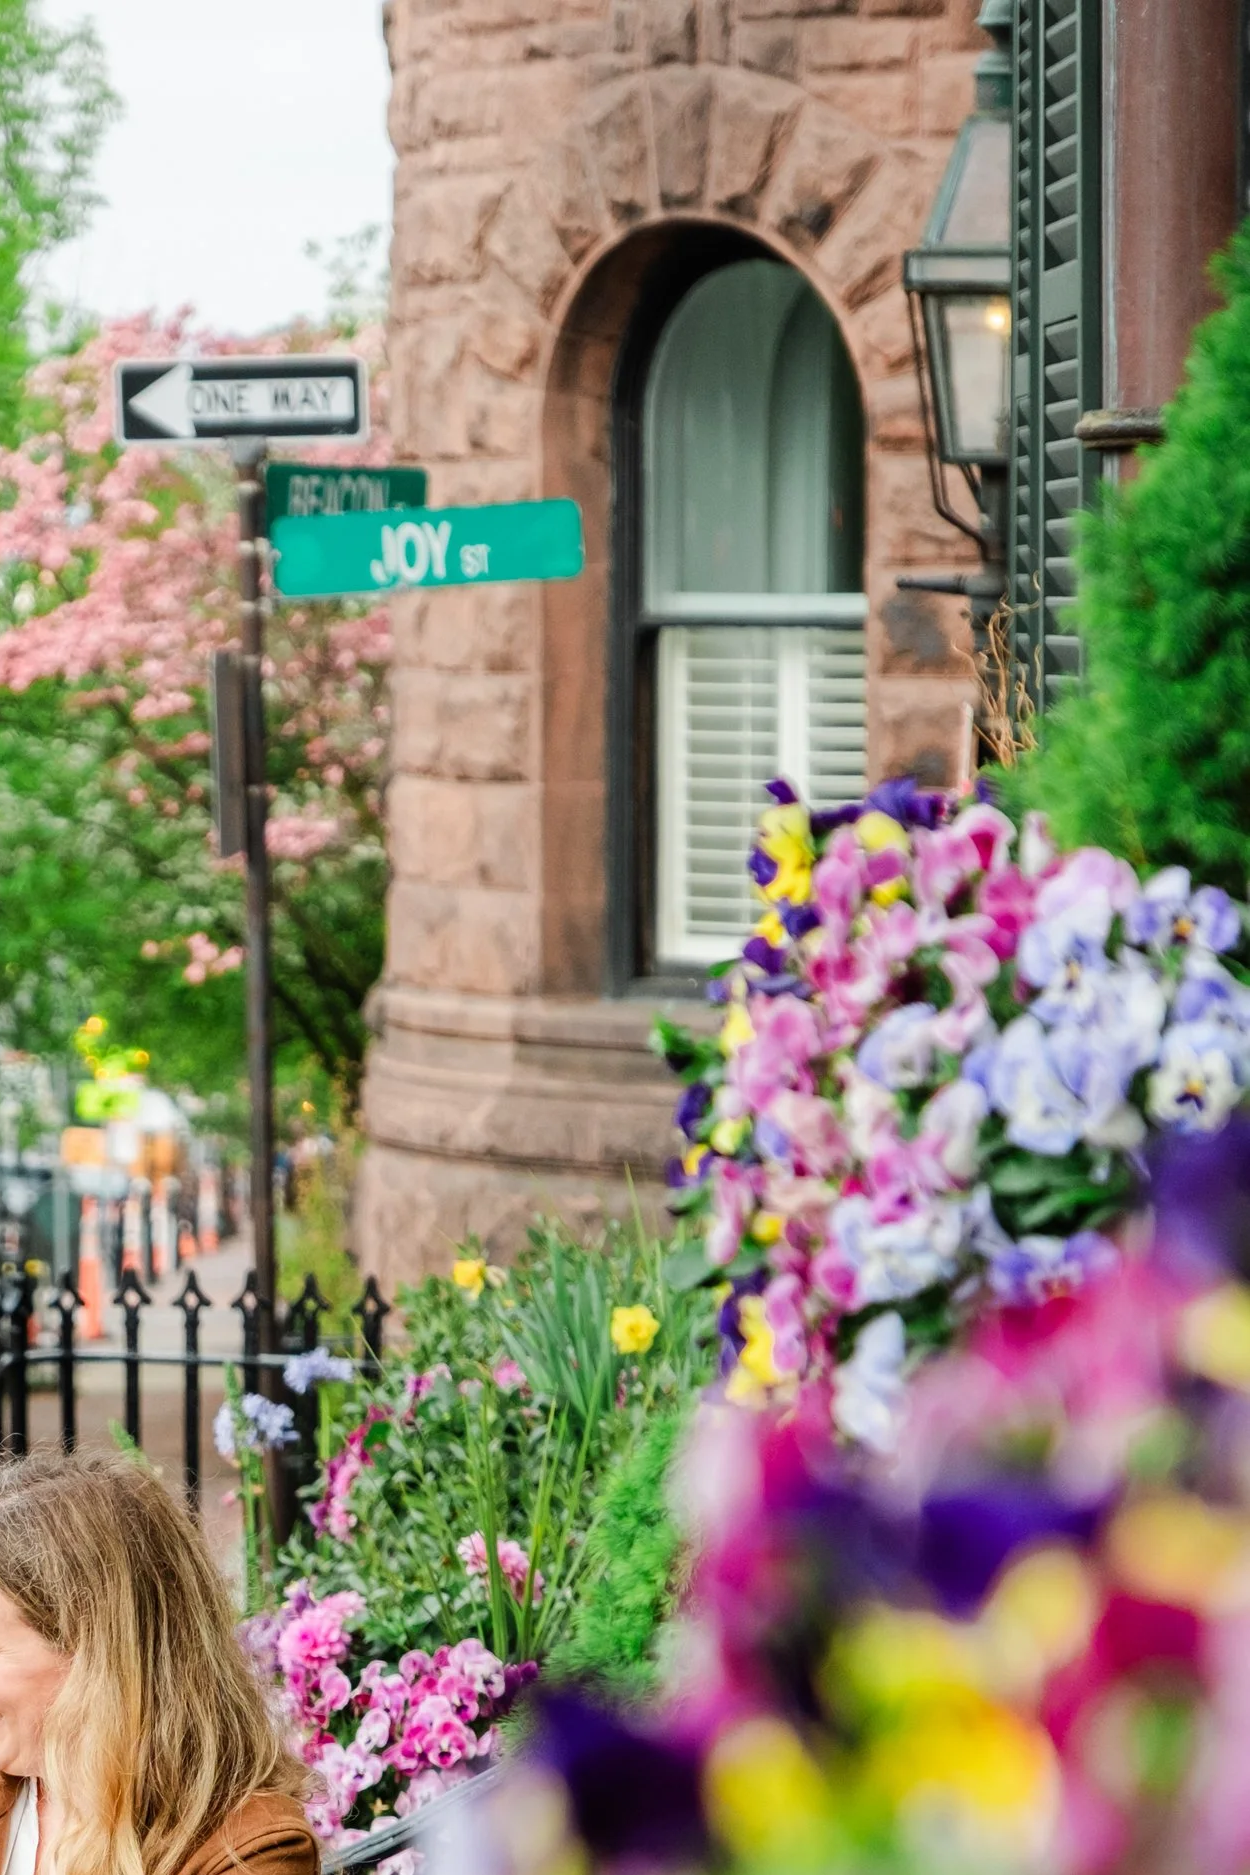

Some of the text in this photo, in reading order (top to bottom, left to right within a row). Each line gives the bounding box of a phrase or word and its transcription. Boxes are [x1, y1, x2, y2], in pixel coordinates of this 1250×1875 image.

[187, 380, 337, 414] ONE WAY
[370, 520, 490, 585] JOY ST
